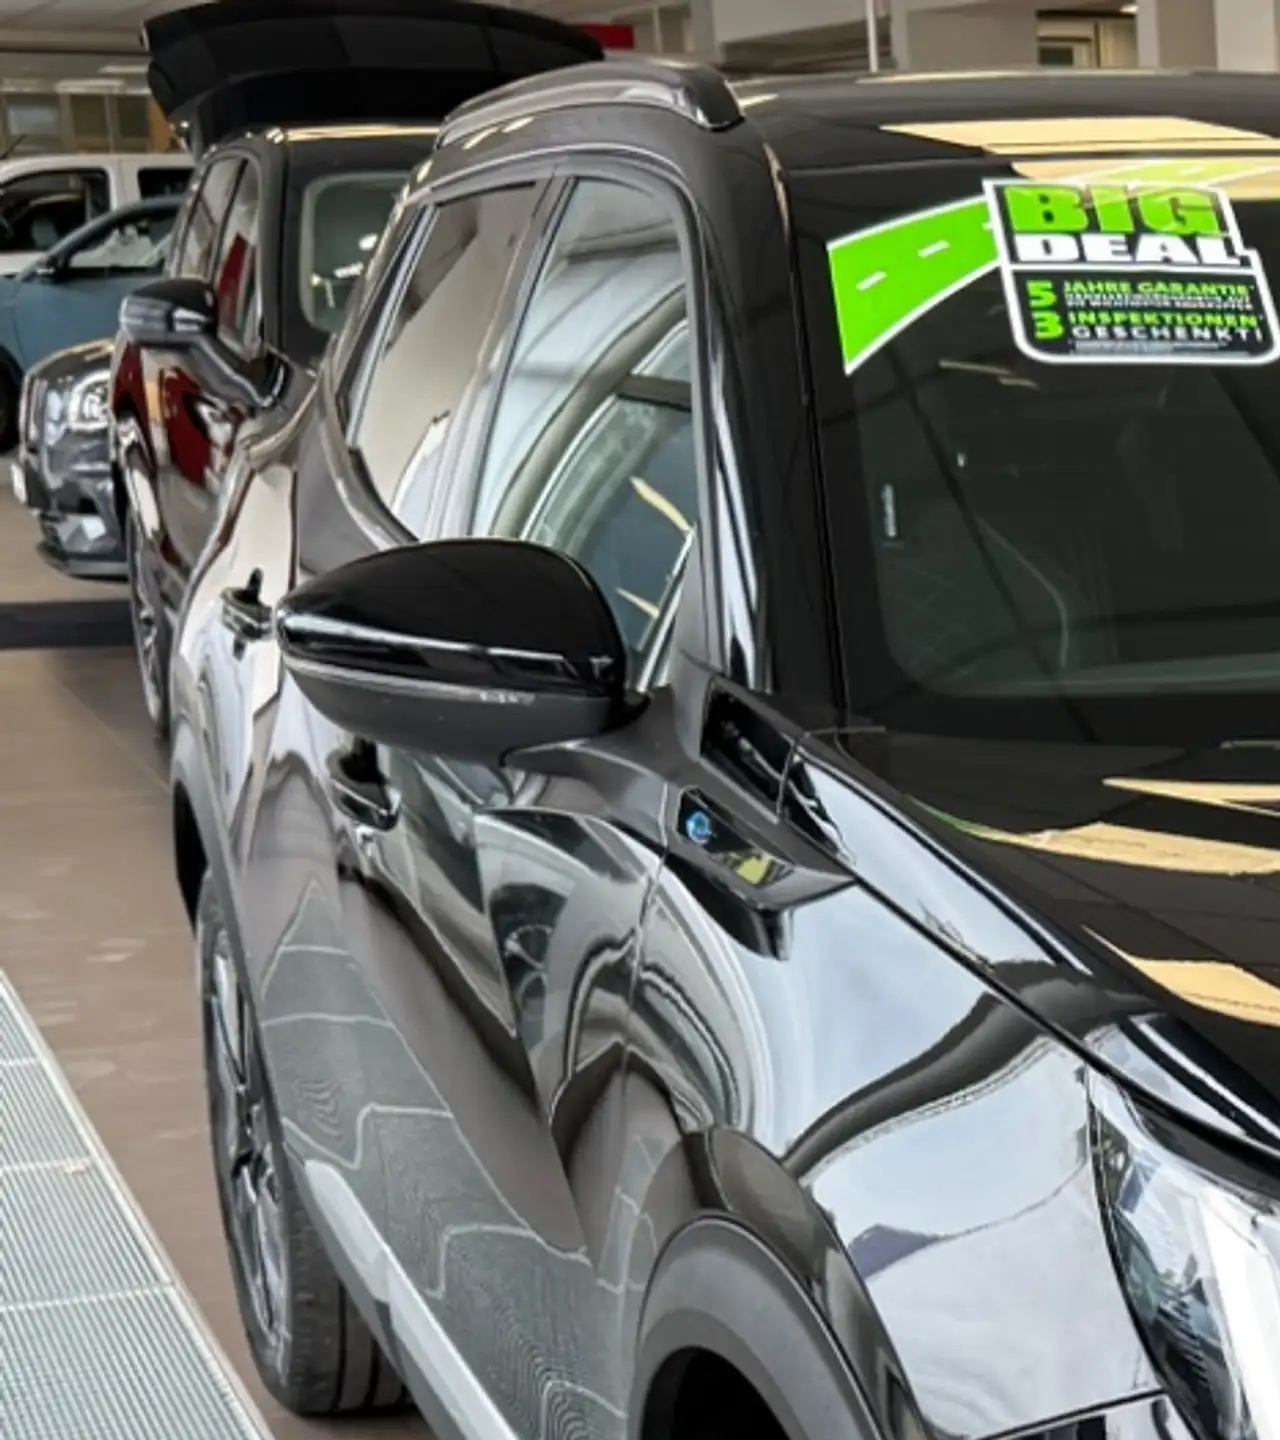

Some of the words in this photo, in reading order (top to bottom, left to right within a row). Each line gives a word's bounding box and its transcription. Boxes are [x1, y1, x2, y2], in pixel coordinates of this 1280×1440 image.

[1004, 185, 1223, 236] BIG
[1026, 279, 1057, 308] 5
[1064, 279, 1132, 294] JAHRE
[1032, 310, 1064, 339] 3
